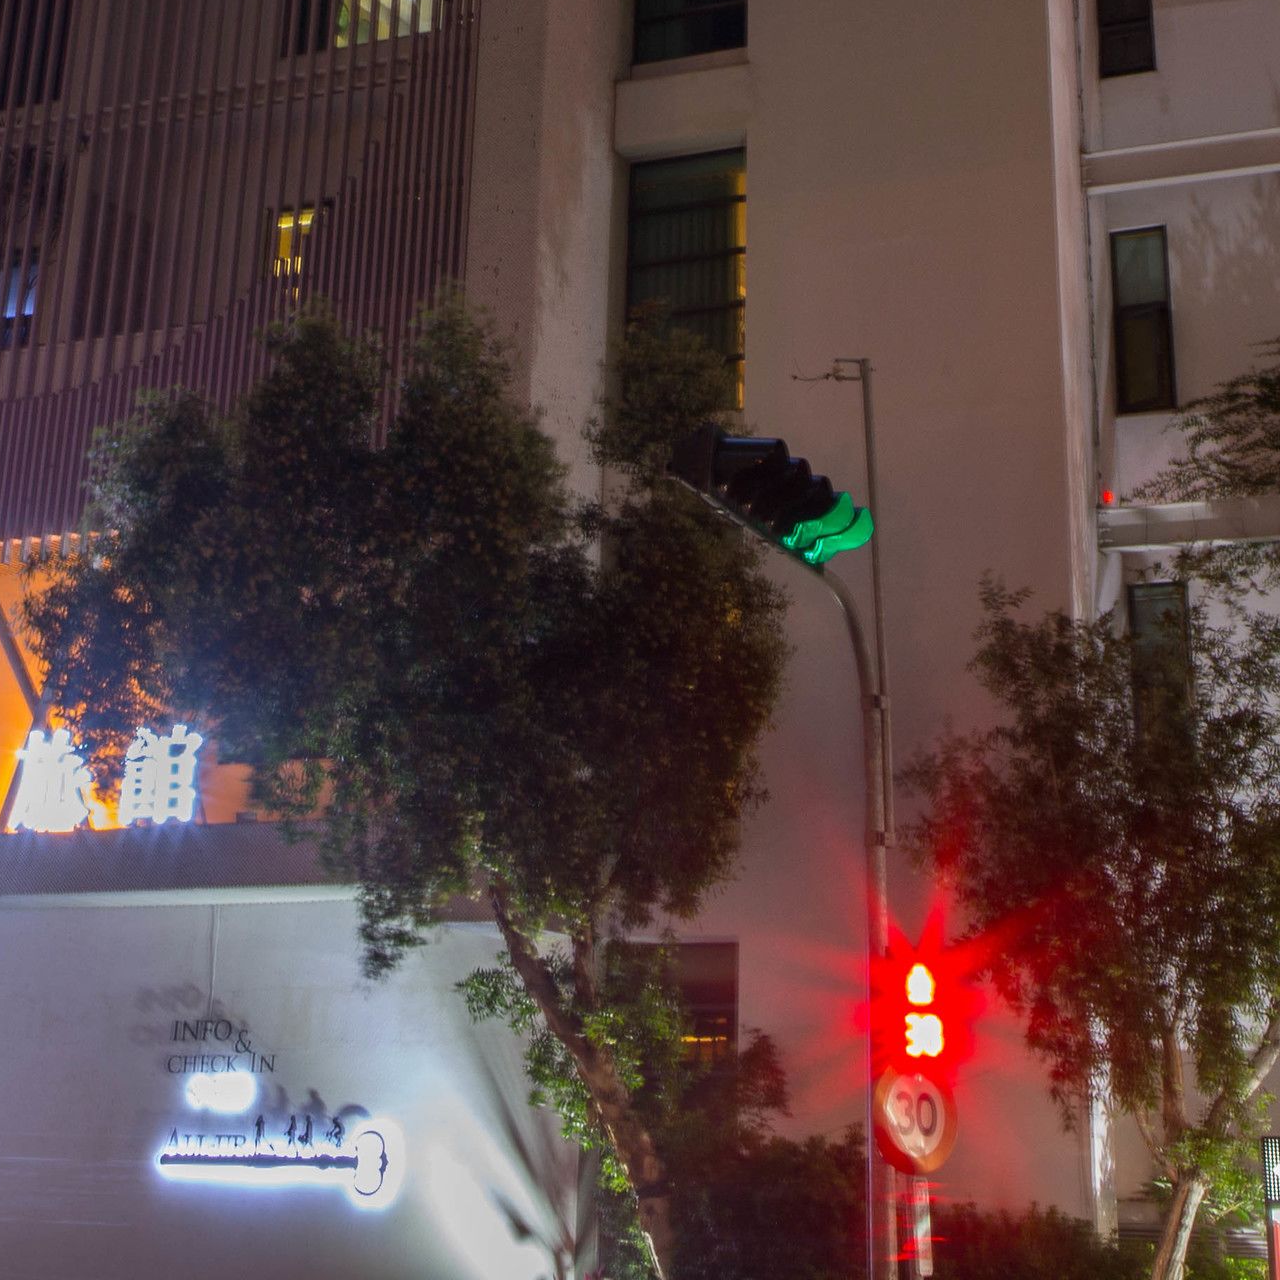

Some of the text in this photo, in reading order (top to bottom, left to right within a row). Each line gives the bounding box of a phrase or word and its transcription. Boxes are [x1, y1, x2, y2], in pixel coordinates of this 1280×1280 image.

[172, 1019, 233, 1042] INFO
[167, 1054, 238, 1074] CHECK
[896, 1090, 938, 1138] 30
